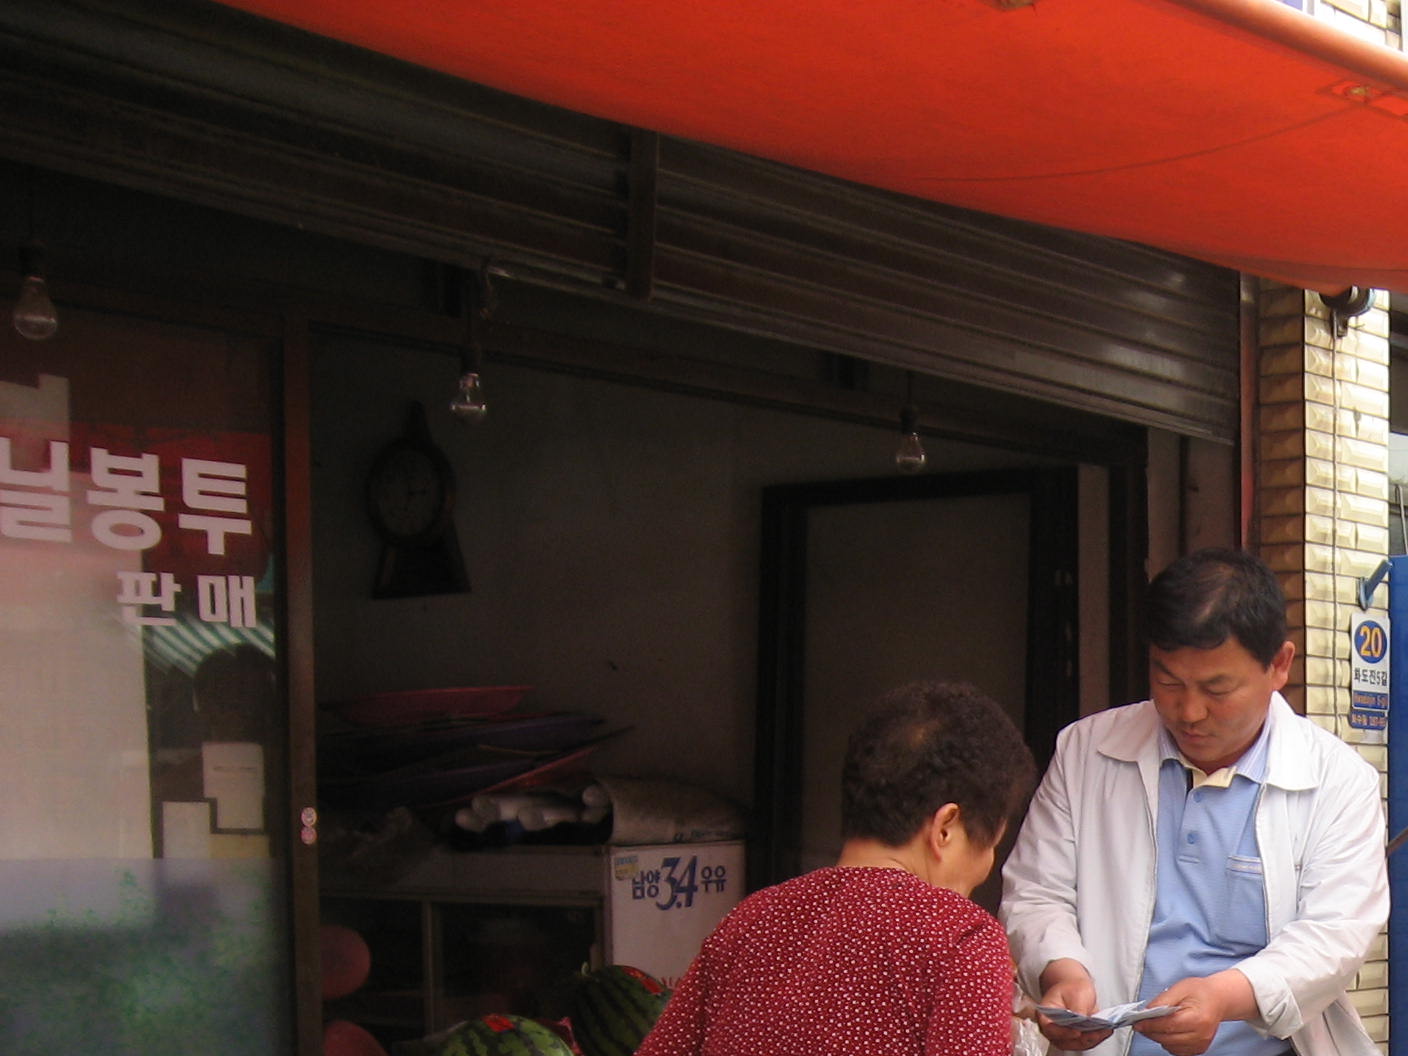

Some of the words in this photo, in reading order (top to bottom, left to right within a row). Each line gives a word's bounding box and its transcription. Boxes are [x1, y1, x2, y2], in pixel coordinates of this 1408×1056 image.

[117, 571, 257, 627] 판매
[1360, 625, 1383, 657] 20
[656, 855, 698, 910] 3.4
